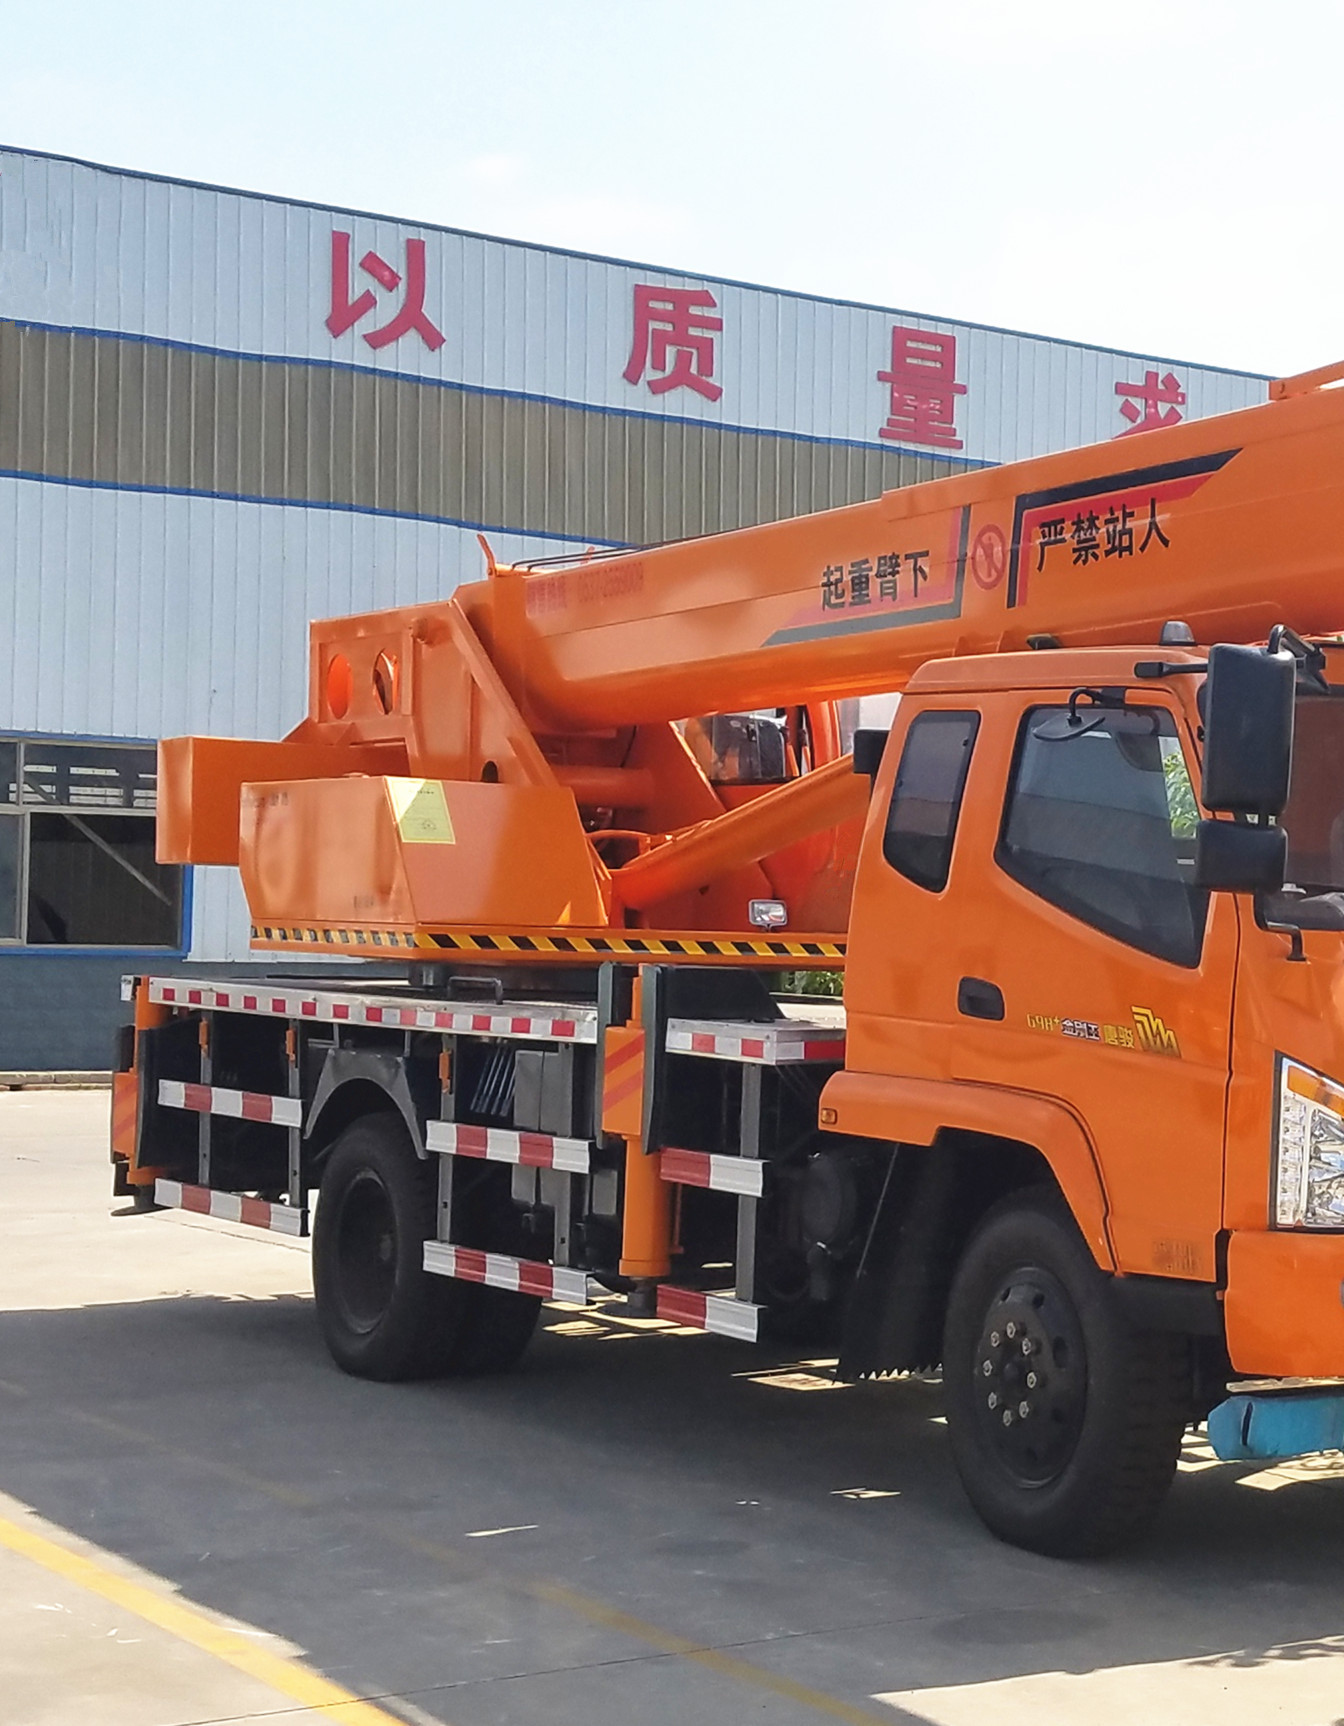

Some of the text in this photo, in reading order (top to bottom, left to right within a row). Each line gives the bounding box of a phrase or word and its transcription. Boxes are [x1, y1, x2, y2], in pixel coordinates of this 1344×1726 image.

[820, 497, 1171, 611] 起重臂下 严禁站人
